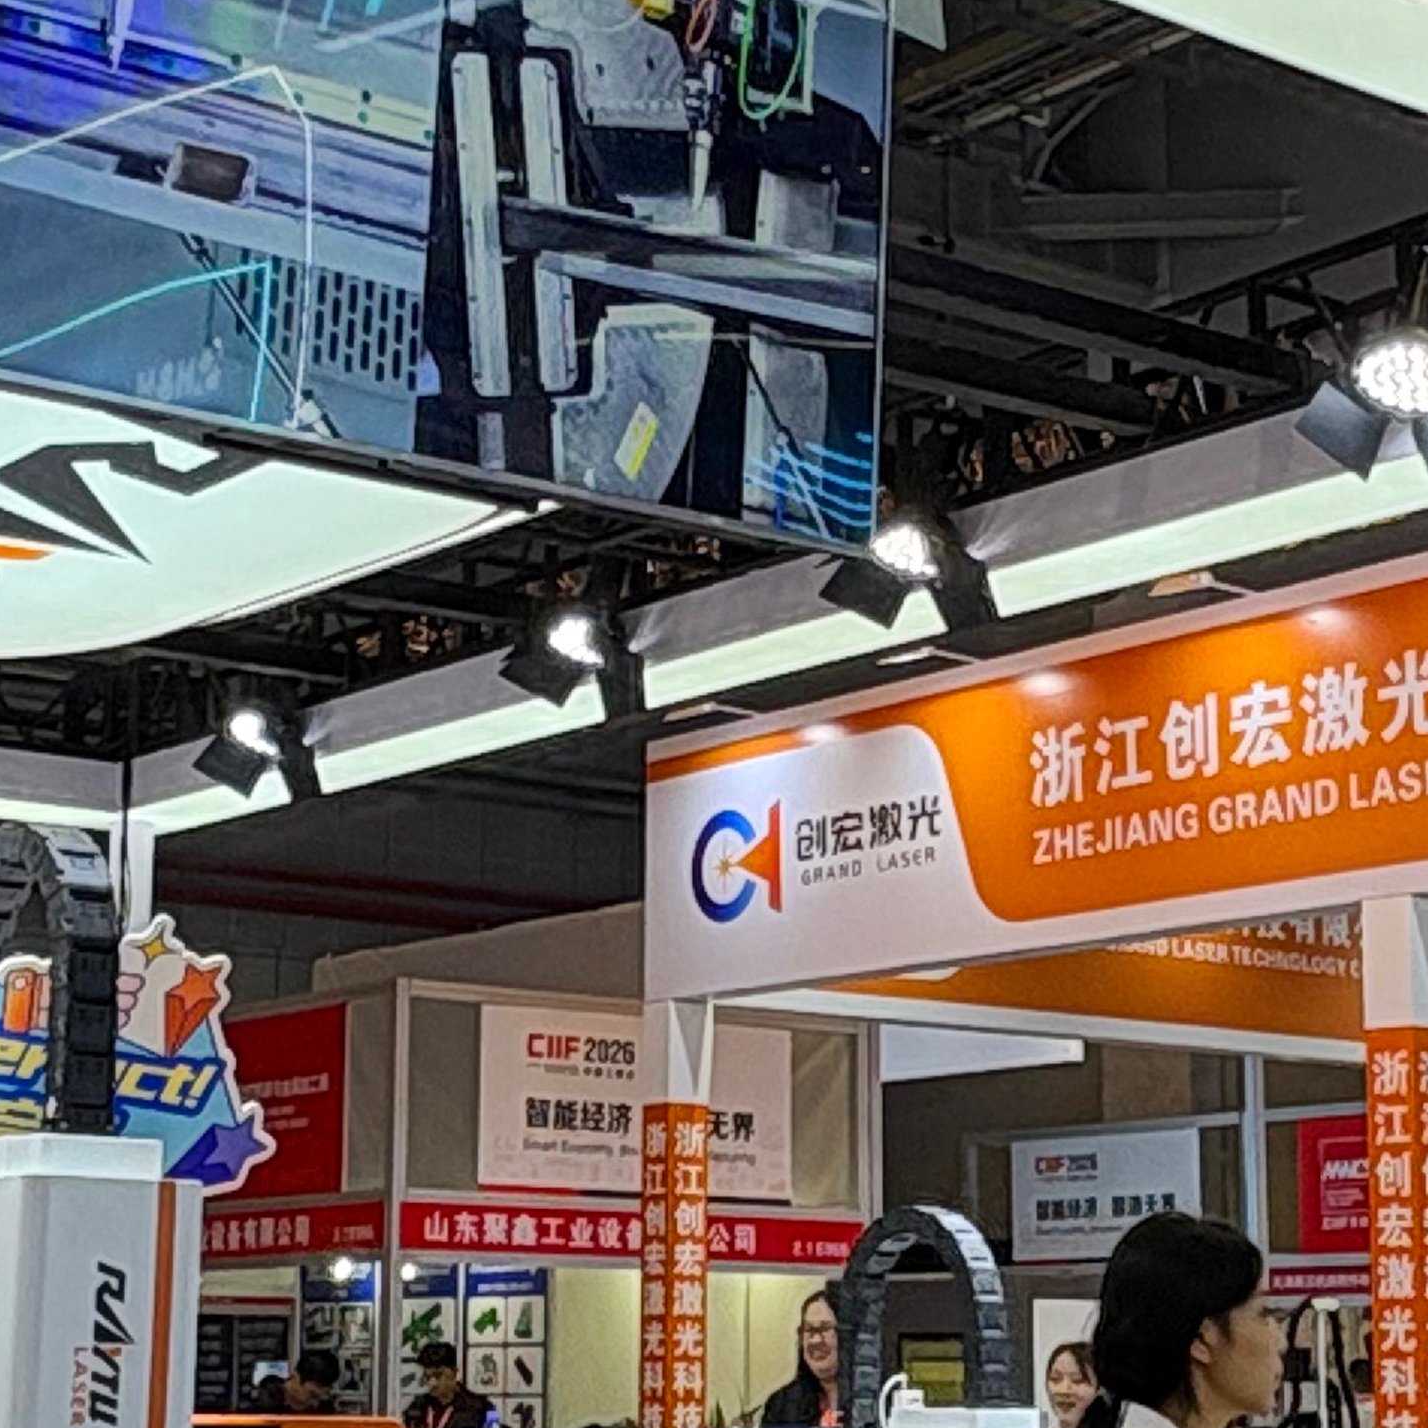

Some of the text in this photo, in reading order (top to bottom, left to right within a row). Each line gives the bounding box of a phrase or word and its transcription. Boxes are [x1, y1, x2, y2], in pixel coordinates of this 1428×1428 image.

[795, 795, 943, 862] 创宏激光
[1032, 803, 1199, 866] ZHEJIANG
[1207, 775, 1340, 836] GRAND
[800, 846, 937, 886] GRAND LASER
[527, 1033, 636, 1065] CIIF 2026
[525, 1096, 633, 1135] 智能经济
[89, 1261, 135, 1427] RAYTU
[70, 1346, 88, 1426] LASER
